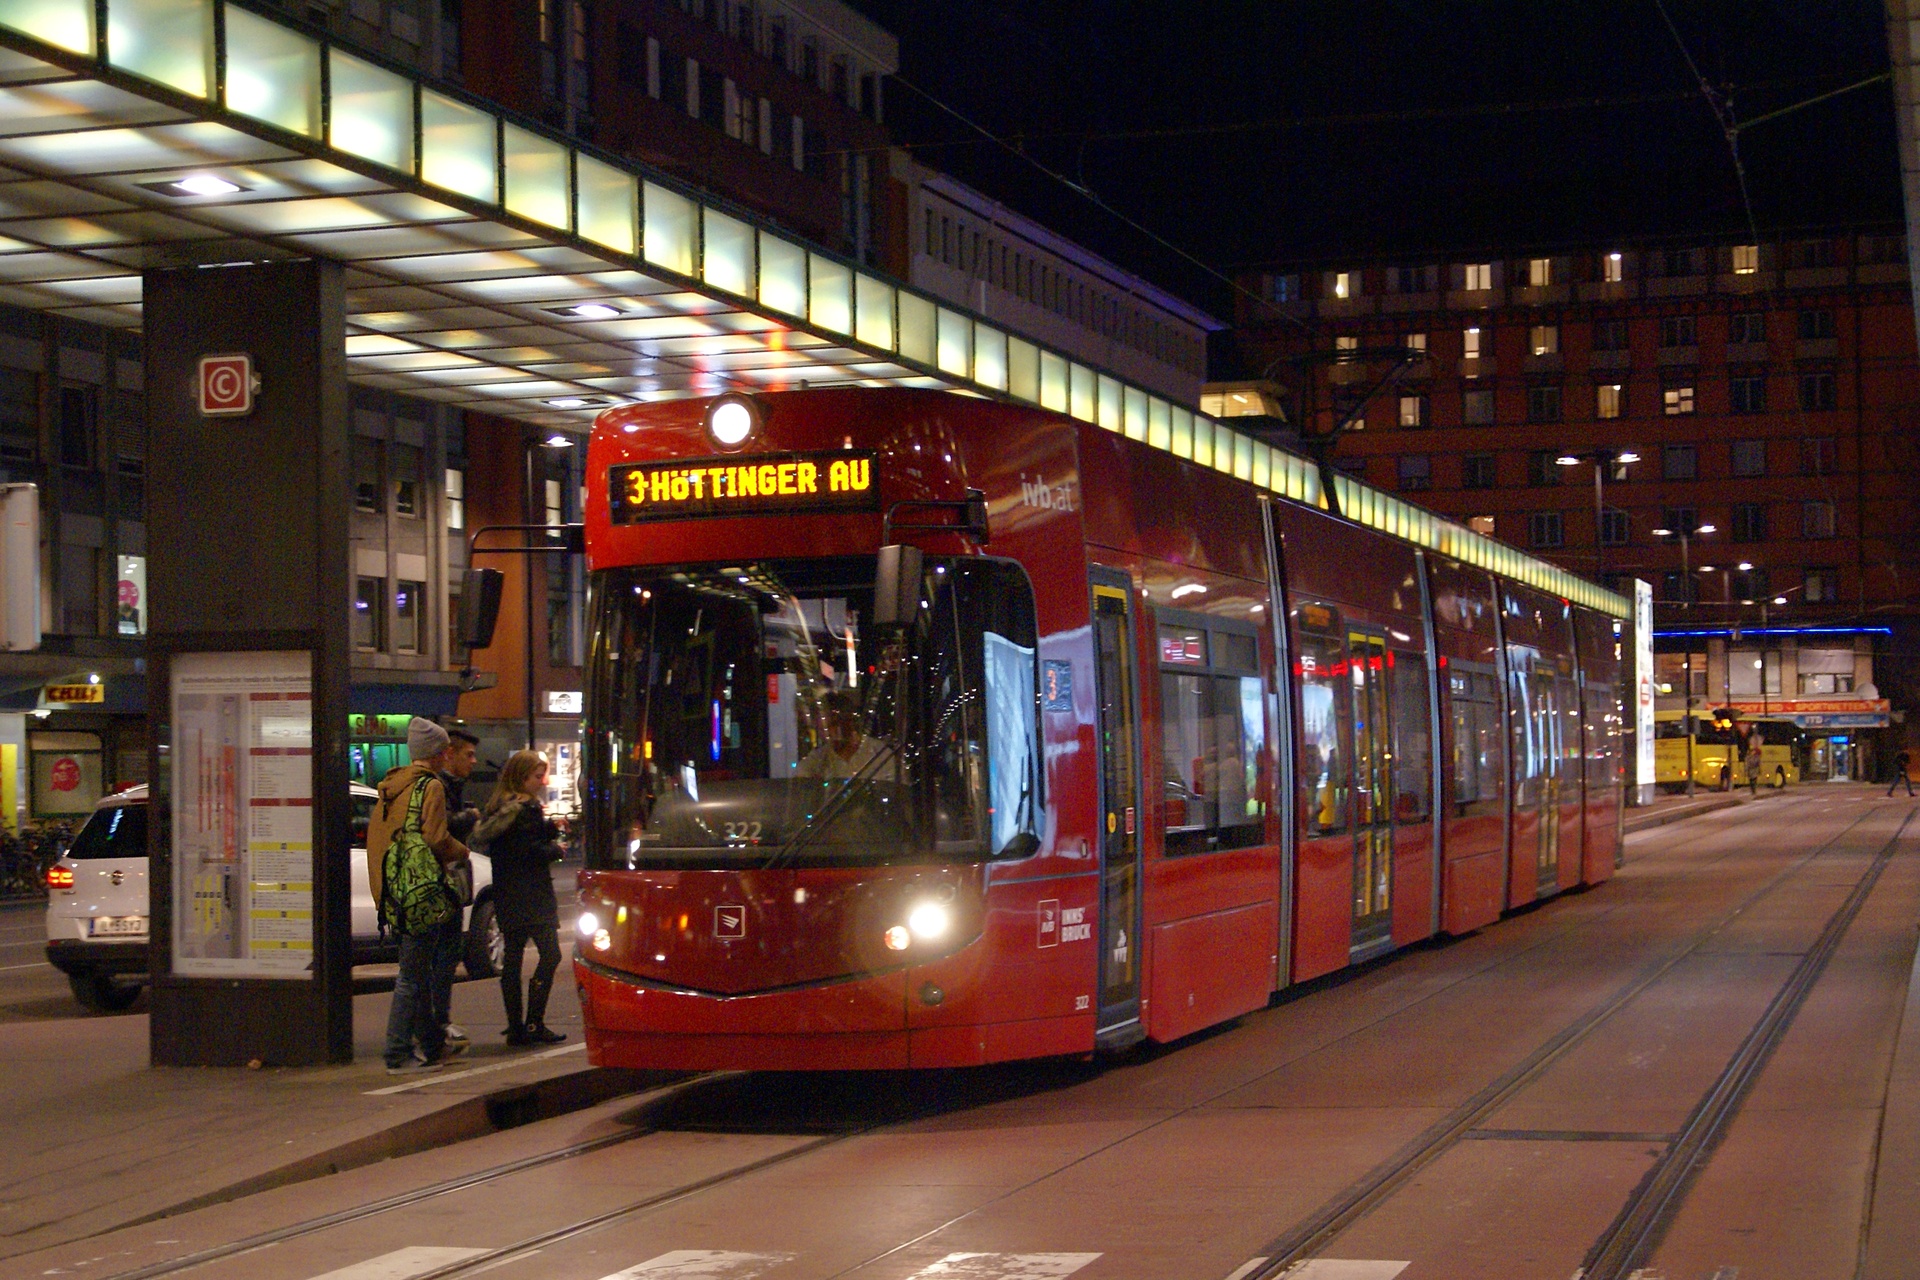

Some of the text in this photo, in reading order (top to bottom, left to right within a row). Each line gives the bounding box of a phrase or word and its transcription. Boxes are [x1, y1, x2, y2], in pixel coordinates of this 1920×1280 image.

[628, 470, 646, 504] 3
[829, 459, 870, 492] AU
[1020, 472, 1074, 512] ivb.at
[724, 821, 762, 841] 322
